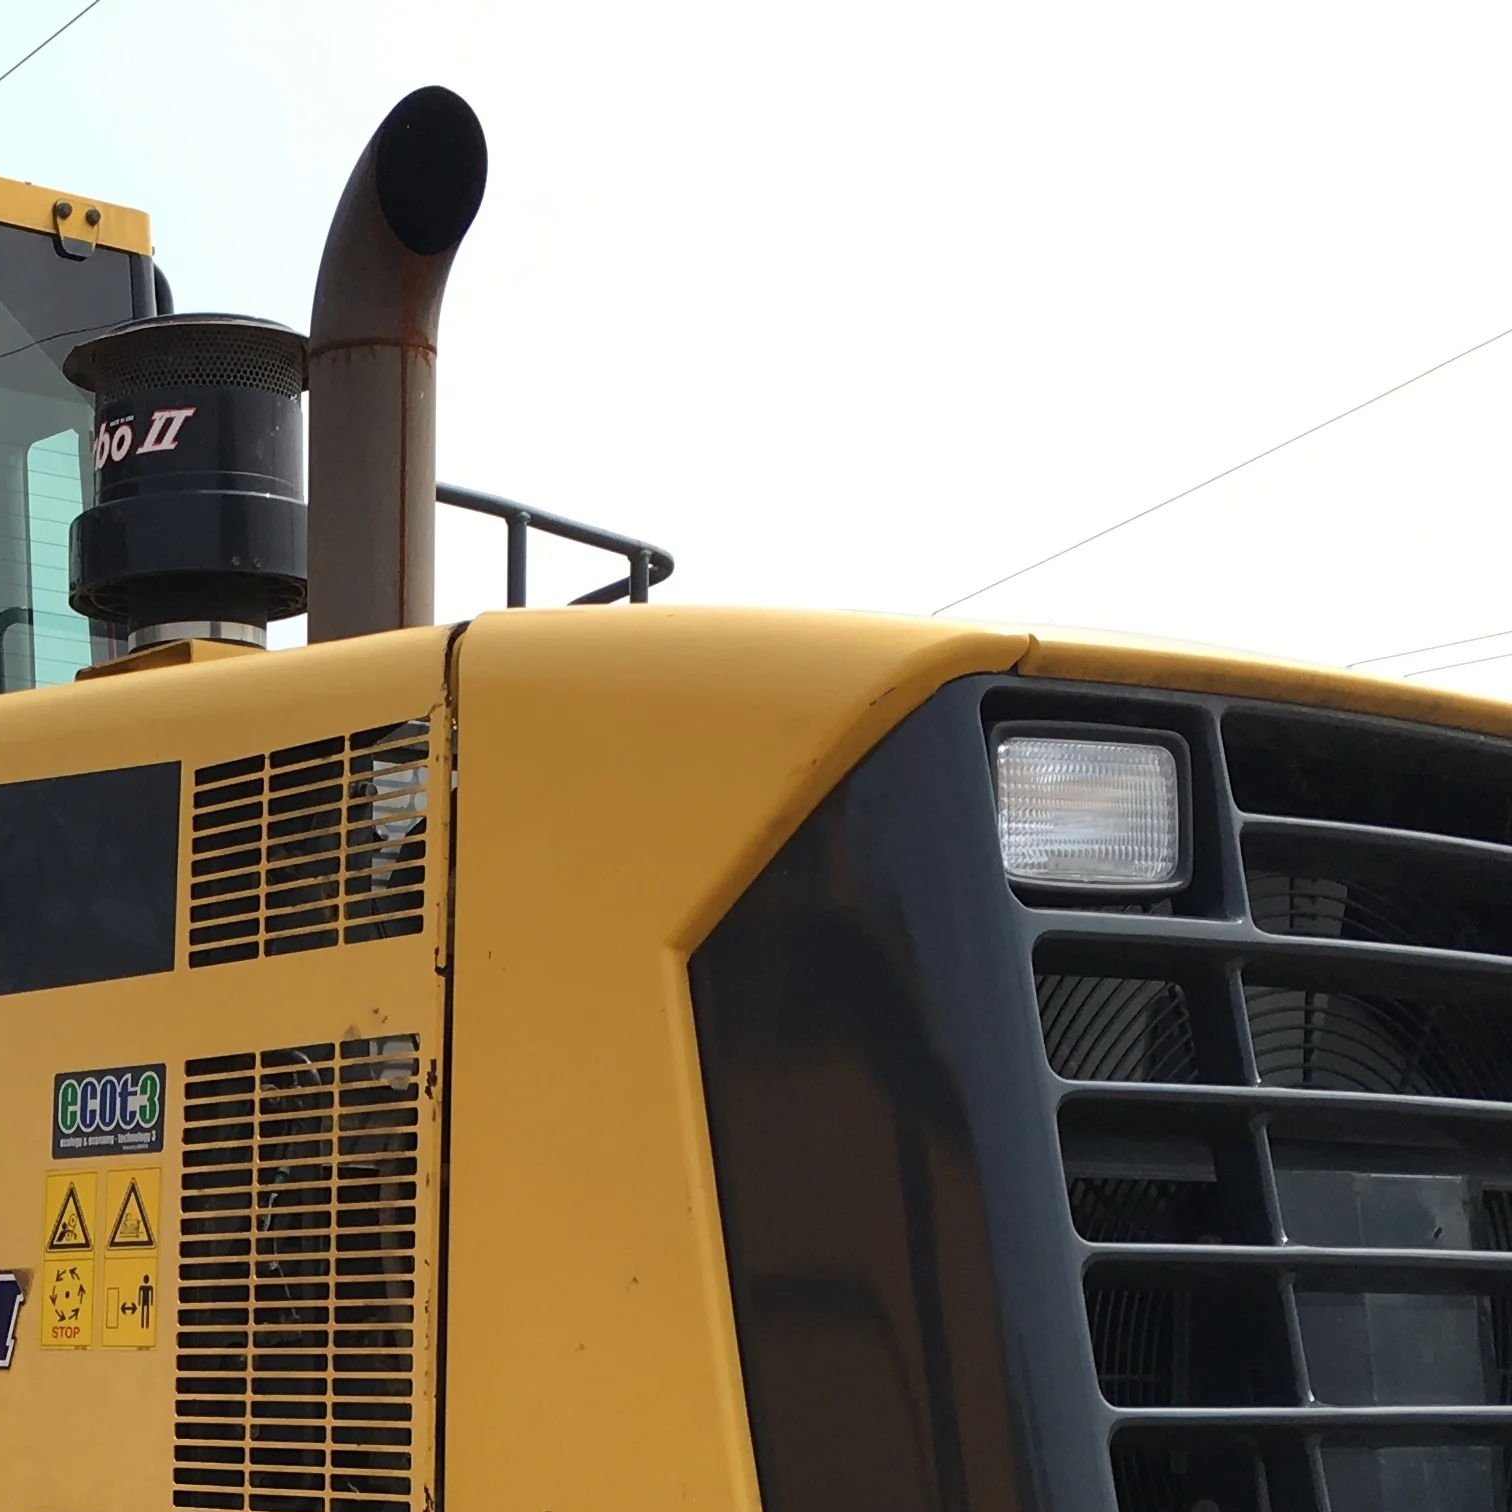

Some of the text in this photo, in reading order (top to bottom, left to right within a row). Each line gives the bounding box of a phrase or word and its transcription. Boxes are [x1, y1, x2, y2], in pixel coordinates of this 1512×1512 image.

[135, 406, 197, 455] II
[58, 1071, 160, 1134] ecot3
[51, 1326, 80, 1339] STOP
